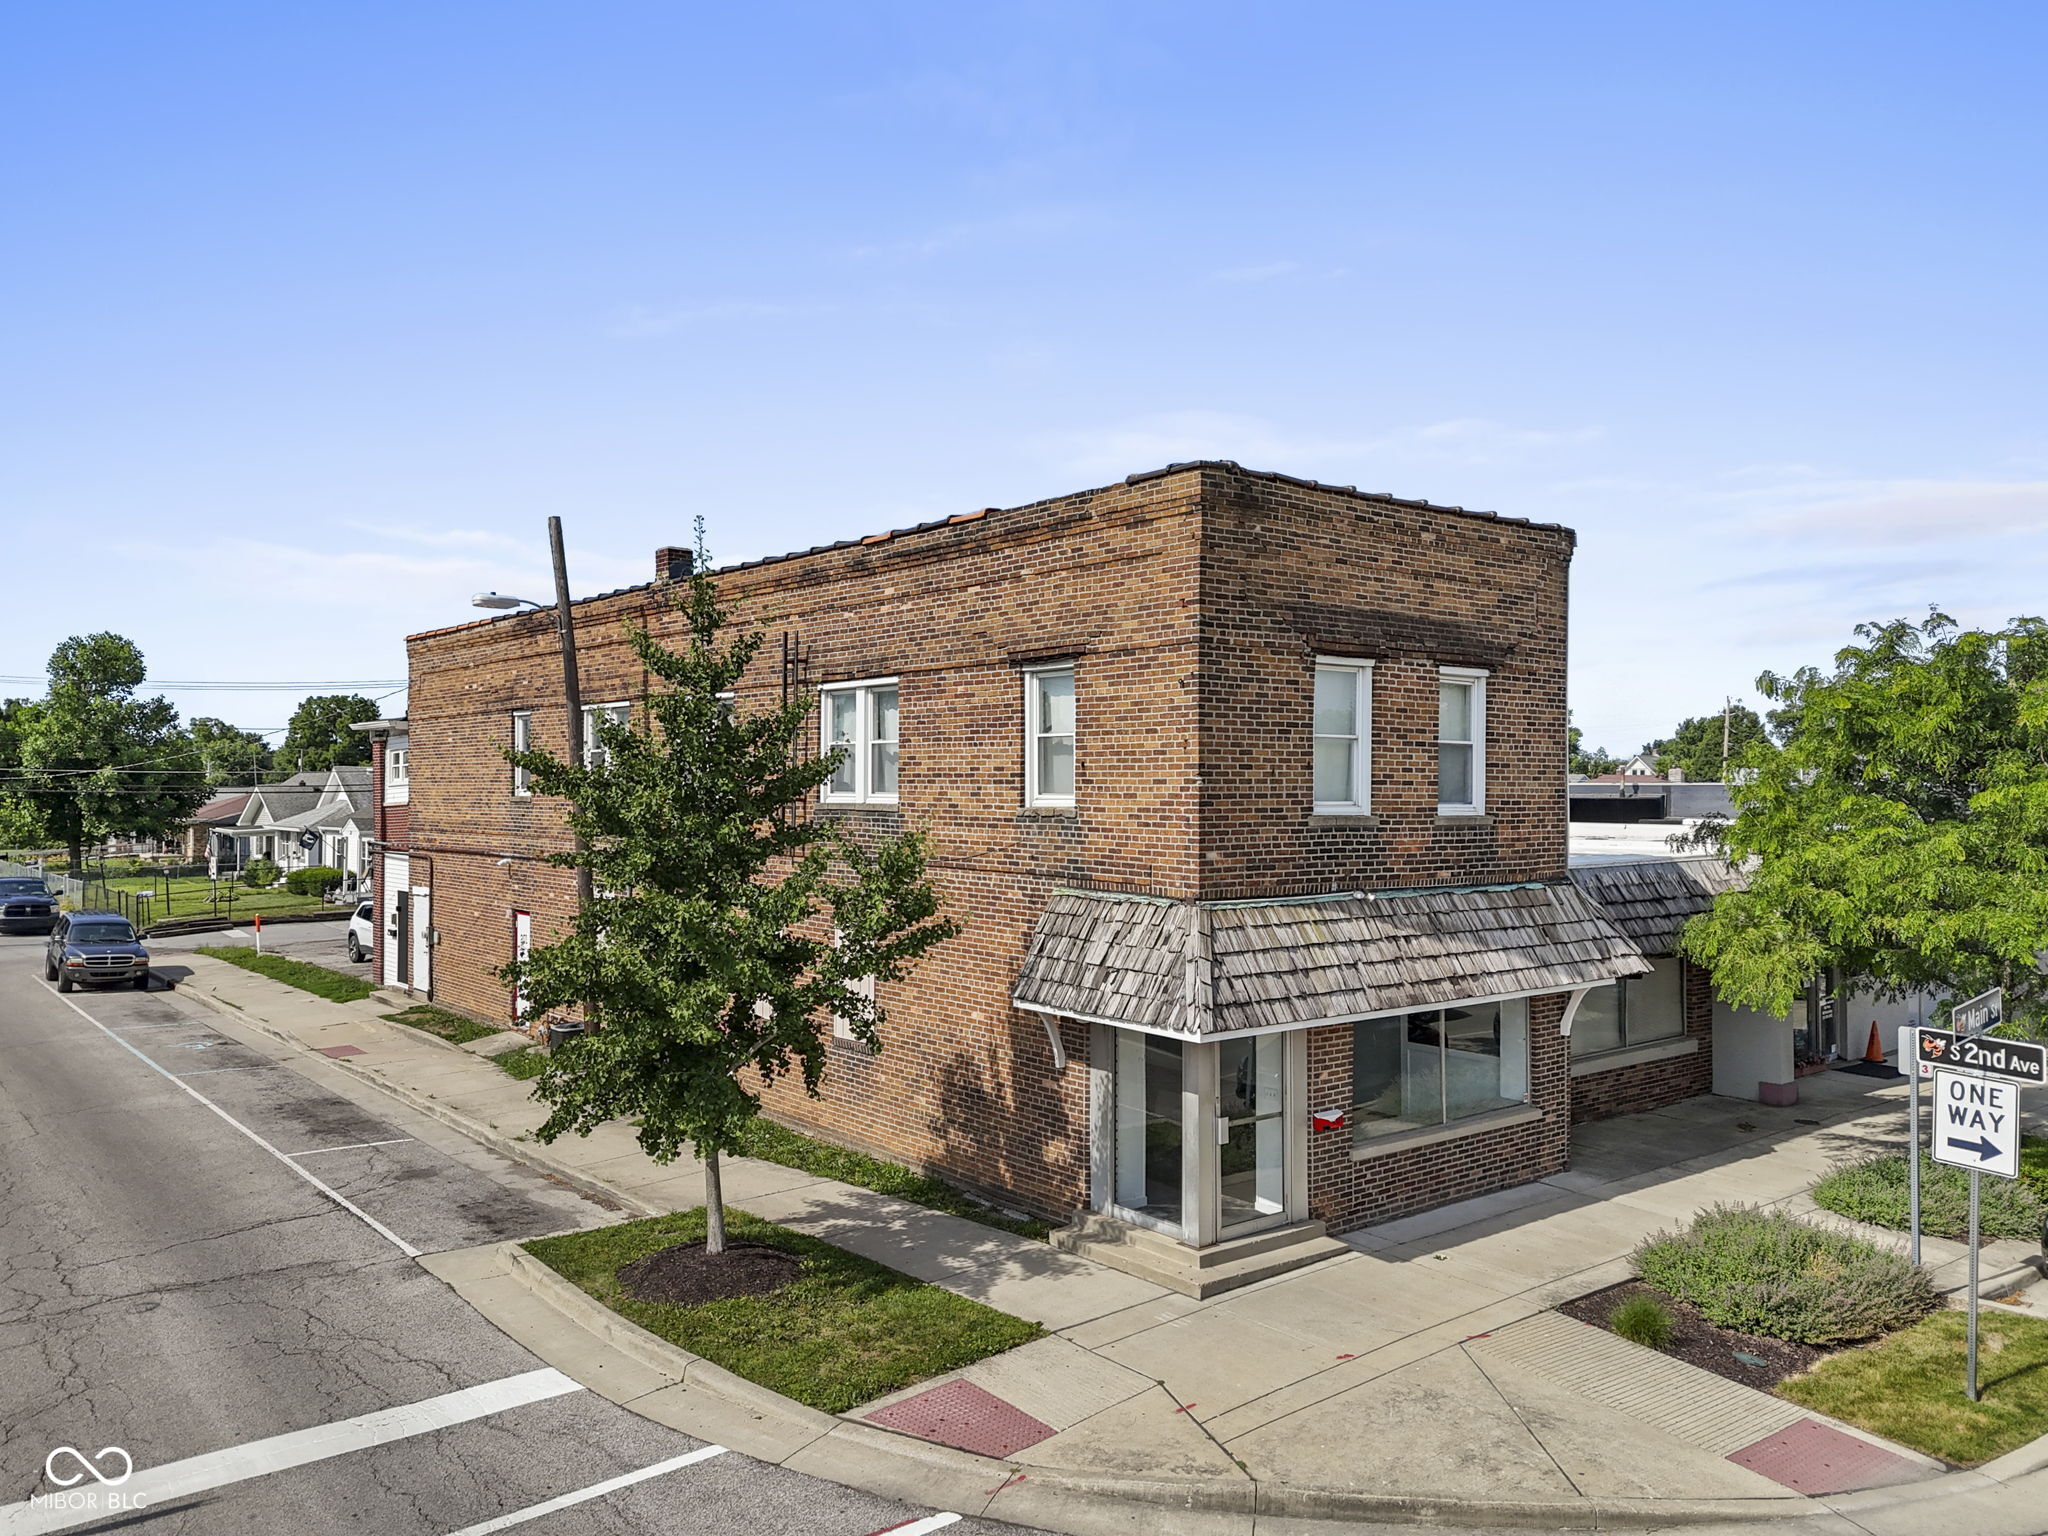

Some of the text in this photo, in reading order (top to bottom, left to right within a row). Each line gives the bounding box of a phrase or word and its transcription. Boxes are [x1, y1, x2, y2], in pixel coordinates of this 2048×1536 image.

[1967, 1004, 1989, 1031] Main
[1921, 1064, 1929, 1074] 3
[1950, 1042, 2040, 1075] S 2nd Ave
[1950, 1080, 2004, 1110] ONE
[1947, 1104, 2006, 1134] WAY
